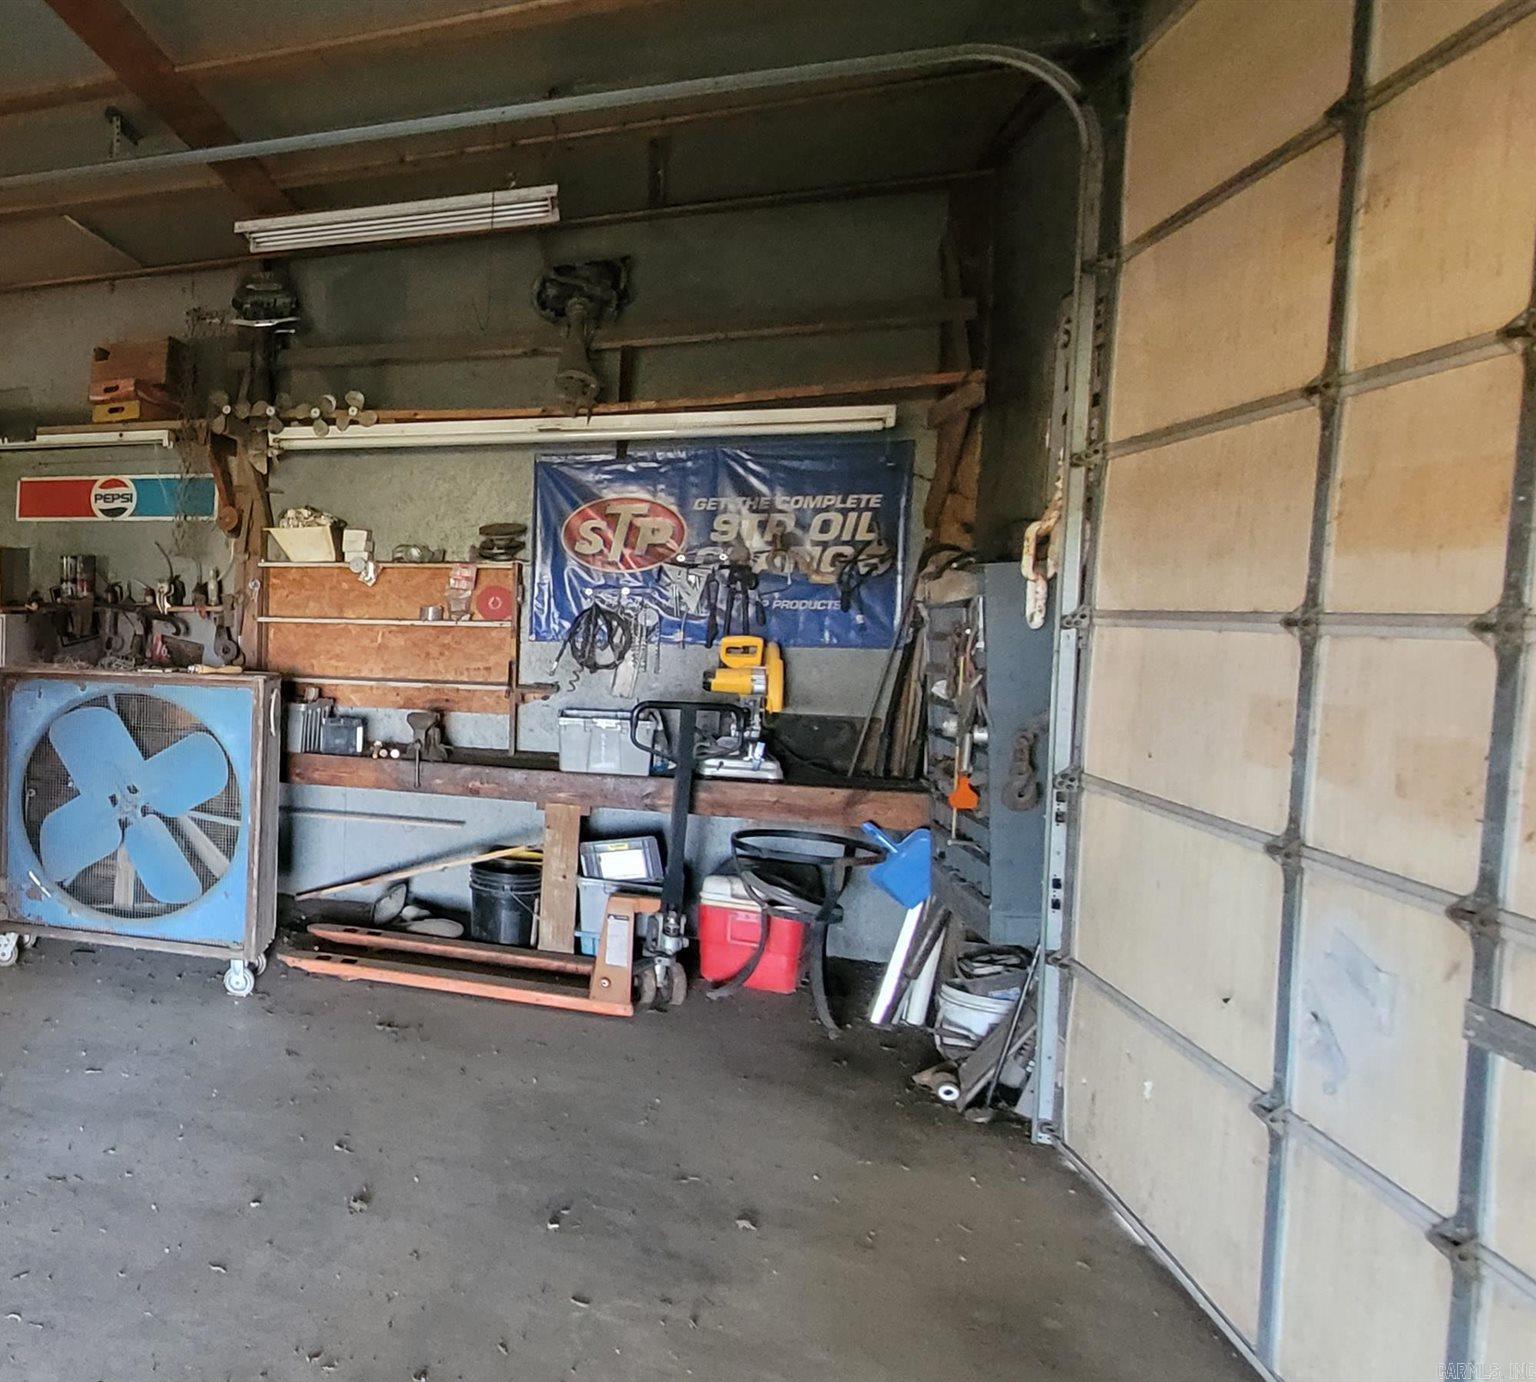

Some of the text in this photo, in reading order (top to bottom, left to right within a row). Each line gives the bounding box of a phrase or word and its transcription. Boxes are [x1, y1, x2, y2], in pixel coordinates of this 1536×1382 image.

[94, 493, 133, 504] PEPSI
[693, 494, 883, 511] GET THE COMPLETE
[574, 503, 676, 562] STP
[710, 511, 878, 542] STP OIL
[772, 599, 841, 611] PRODUCTS
